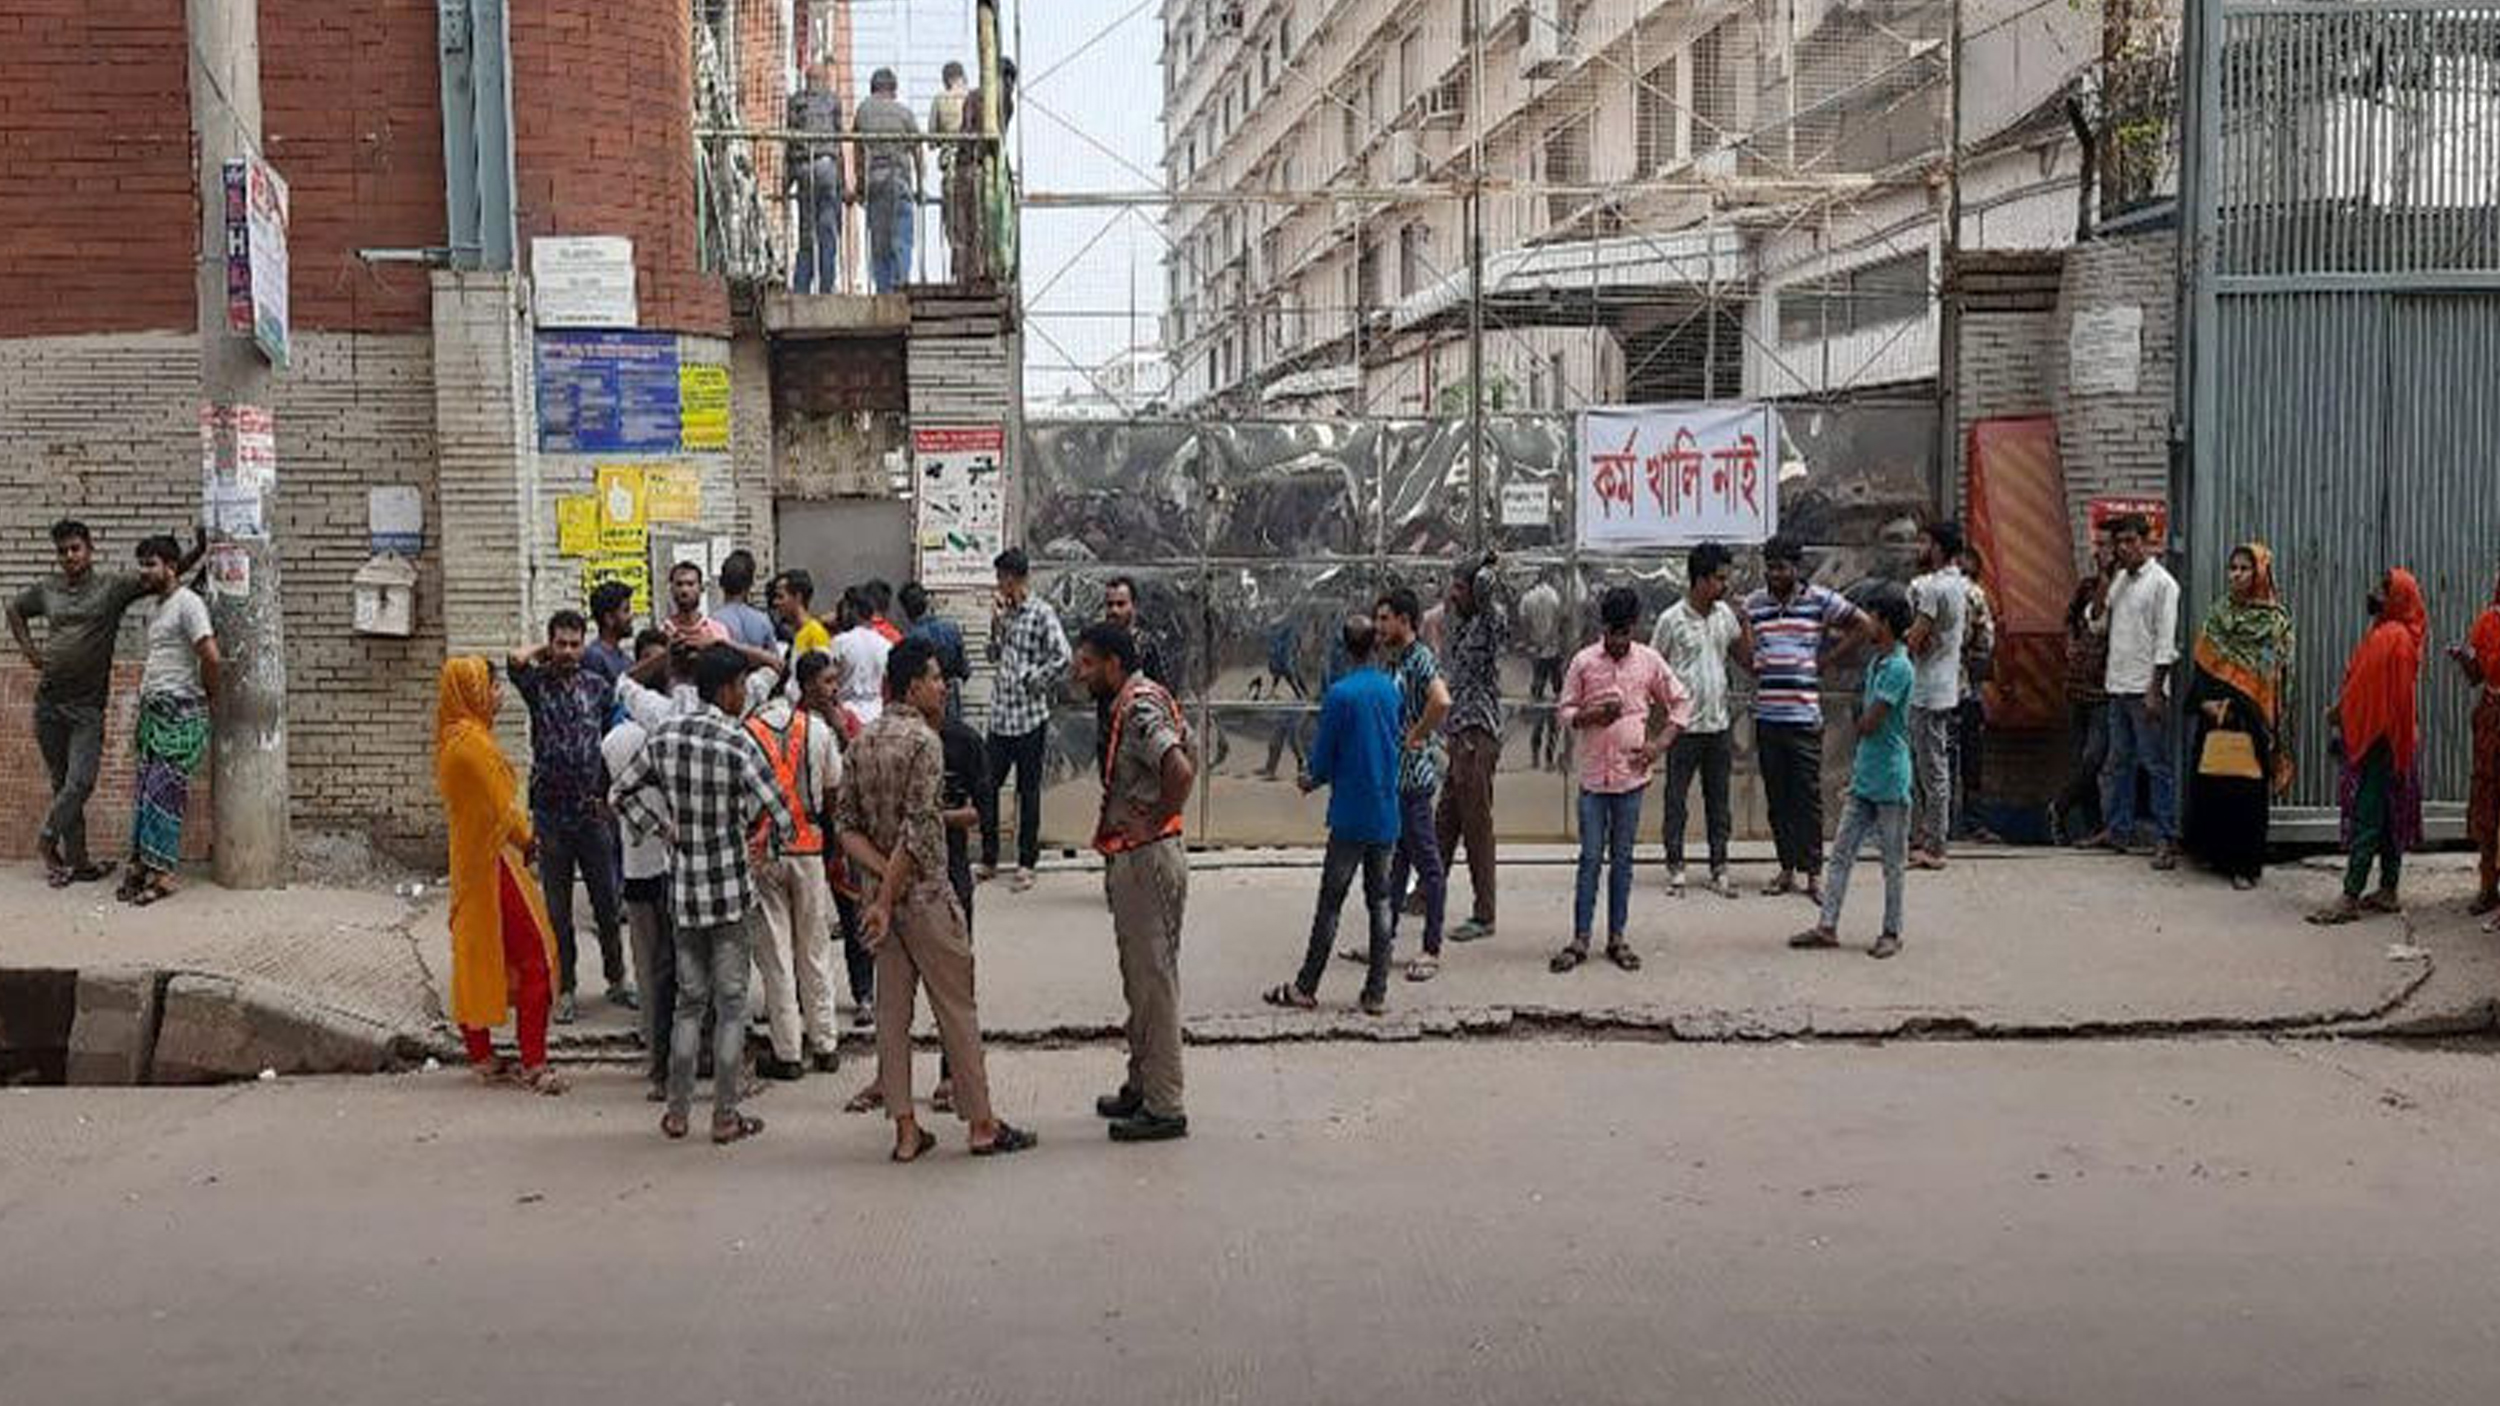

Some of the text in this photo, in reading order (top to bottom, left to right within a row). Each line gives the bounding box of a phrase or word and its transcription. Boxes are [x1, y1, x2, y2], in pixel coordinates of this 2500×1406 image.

[1591, 426, 1761, 518] কর্ম খালি নাই
